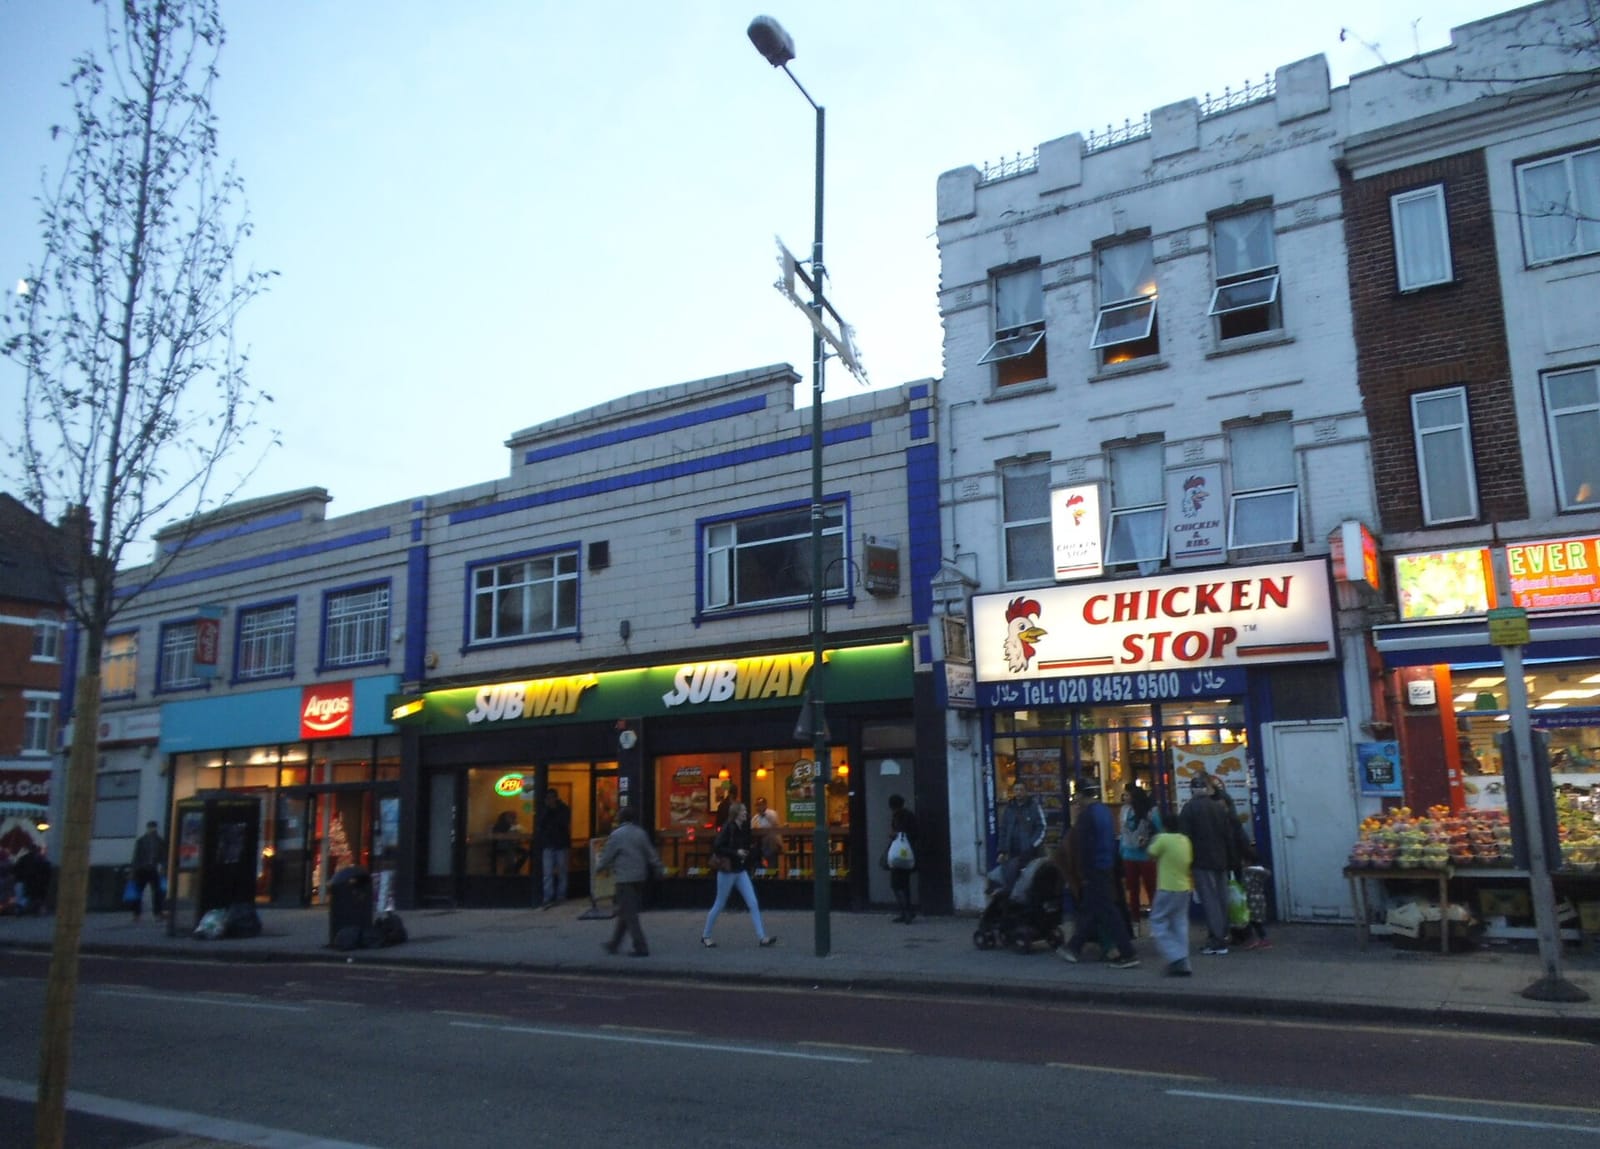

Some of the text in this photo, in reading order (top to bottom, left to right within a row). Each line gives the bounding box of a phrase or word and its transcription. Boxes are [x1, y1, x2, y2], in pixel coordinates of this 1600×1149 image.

[1174, 519, 1220, 532] CHICKEN
[1186, 537, 1211, 548] RIBS
[1507, 541, 1588, 575] EVER
[1083, 575, 1294, 625] CHICKEN
[1121, 626, 1237, 664] STOP
[662, 651, 829, 708] SUBWAY
[1059, 677, 1087, 703] 020
[1092, 674, 1133, 702] 8452
[1137, 671, 1180, 699] 9500
[304, 695, 349, 721] Argos
[466, 673, 598, 724] SUBWAY
[15, 779, 51, 797] Caf
